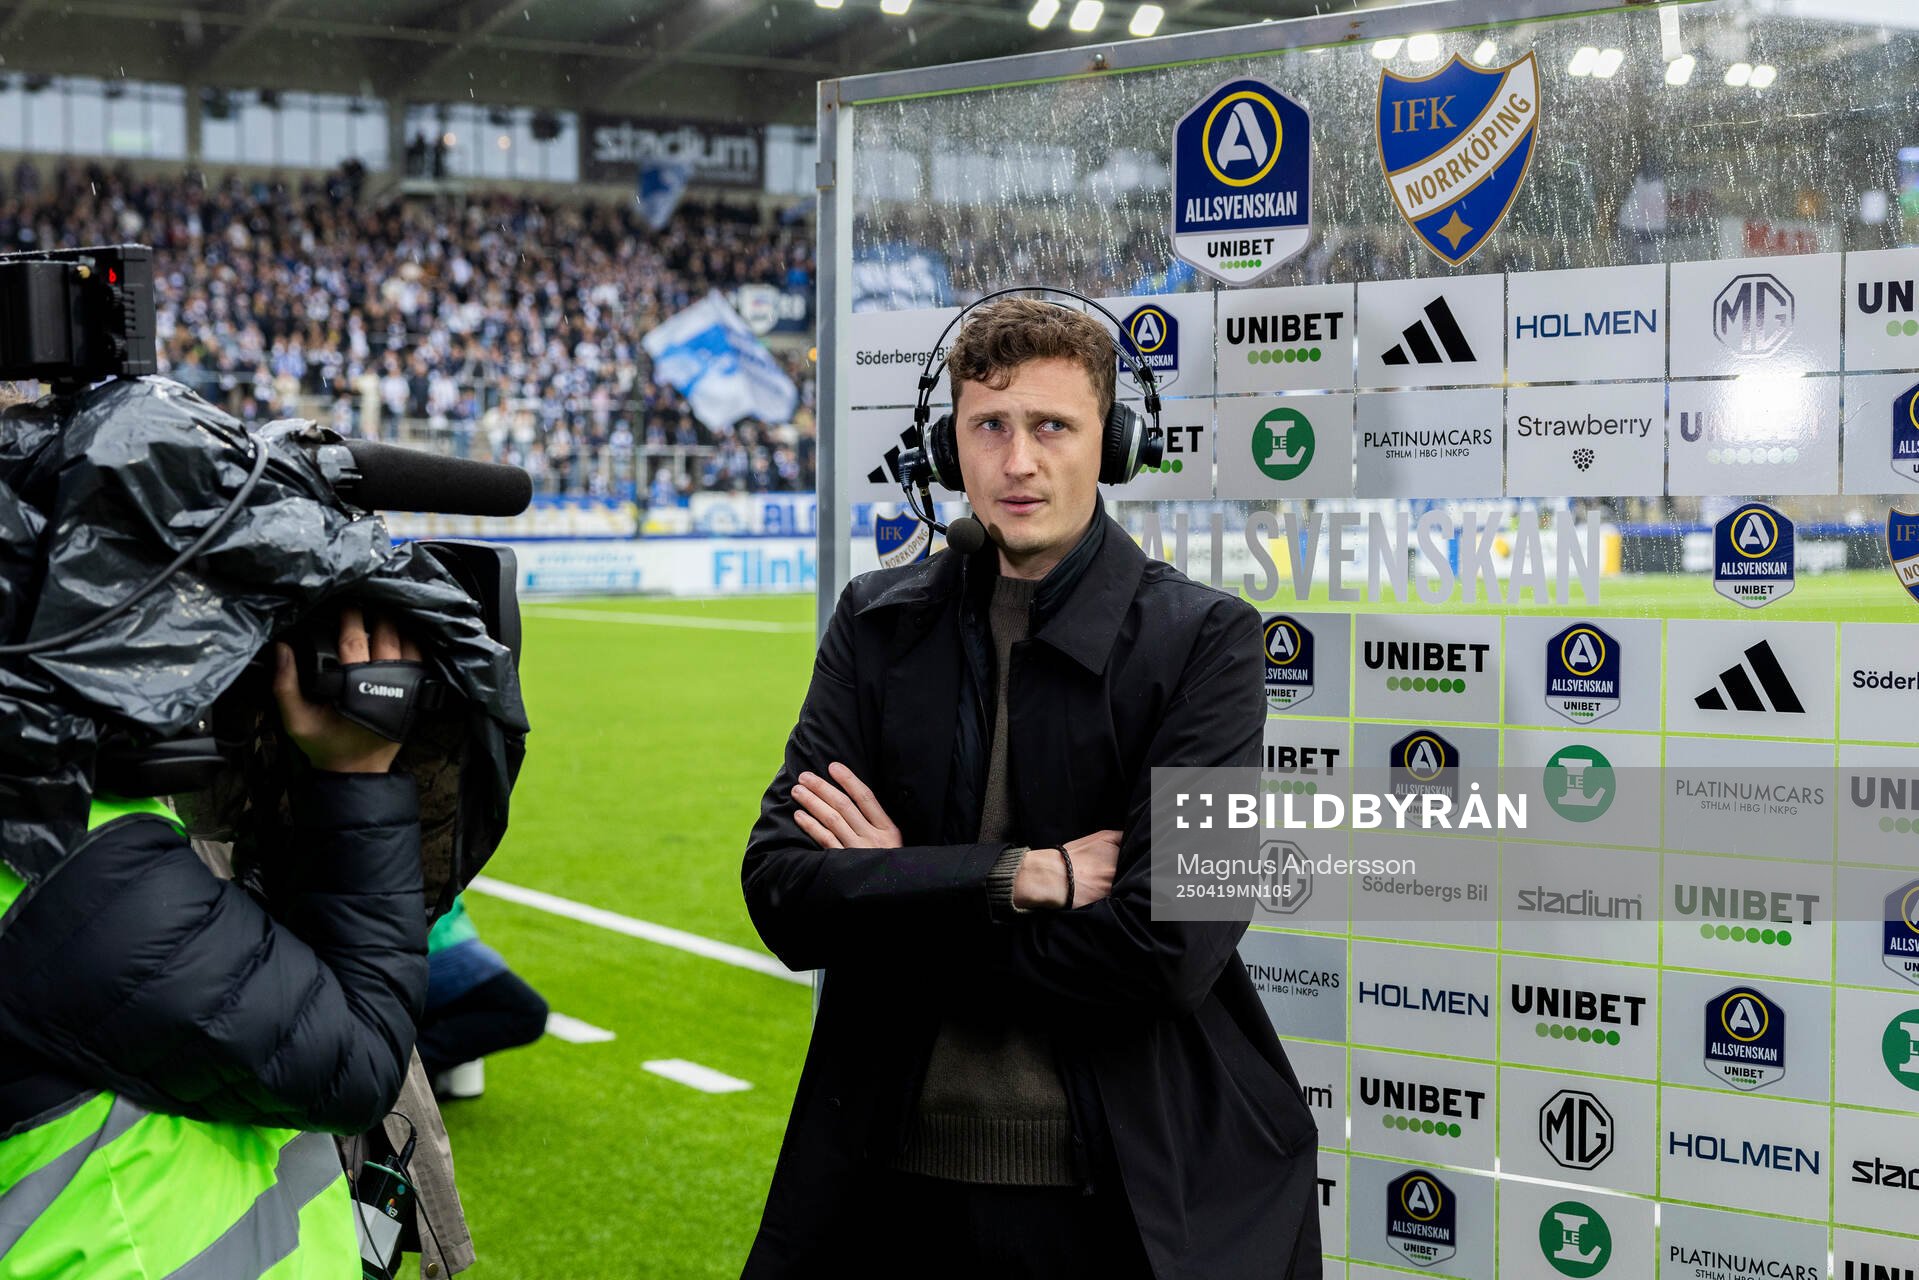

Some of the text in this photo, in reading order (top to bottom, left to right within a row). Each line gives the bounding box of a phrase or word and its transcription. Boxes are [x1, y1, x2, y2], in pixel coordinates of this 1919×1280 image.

[1392, 95, 1456, 134] IFK
[1405, 92, 1531, 210] NORRKÖPING
[1185, 191, 1297, 223] ALLSVENSKAN
[1207, 238, 1275, 259] UNIBET
[1226, 312, 1343, 345] UNIBET
[1516, 309, 1657, 339] HOLMEN
[856, 349, 932, 366] Söderbergs
[1517, 414, 1652, 439] Strawberry
[1364, 429, 1492, 448] PLATINUMCARS
[1385, 448, 1470, 459] STHLM HBG NKPG
[881, 526, 903, 540] IFK
[1720, 561, 1787, 576] ALLSVENSKAN
[1734, 584, 1774, 595] UNIBET
[1364, 640, 1490, 673] UNIBET
[359, 681, 404, 698] Canon
[1551, 678, 1614, 694] ALLSVENSKAN
[1853, 669, 1919, 690] Söder
[1266, 688, 1297, 697] UNIBET
[1563, 701, 1601, 712] UNIBET
[1262, 745, 1340, 776] IBET
[1676, 779, 1824, 805] PLATINUMCARS
[1700, 800, 1798, 816] STHLM HBG NKPG
[1362, 876, 1488, 902] Söderbergs Bil
[1517, 885, 1642, 921] stadium
[1674, 883, 1820, 926] UNIBET
[1272, 984, 1289, 994] HBG
[1296, 987, 1319, 997] NKPG
[1359, 981, 1489, 1018] HOLMEN
[1511, 983, 1646, 1026] UNIBET
[1711, 1042, 1778, 1062] ALLSVENSKAN
[1724, 1065, 1764, 1080] UNIBET
[1360, 1076, 1485, 1120] UNIBET
[1546, 1097, 1607, 1163] MG
[1669, 1131, 1820, 1175] HOLMEN
[1392, 1220, 1450, 1240] ALLSVENSKAN
[1404, 1242, 1439, 1256] UNIBET
[1670, 1246, 1818, 1280] PLATINUMCARS
